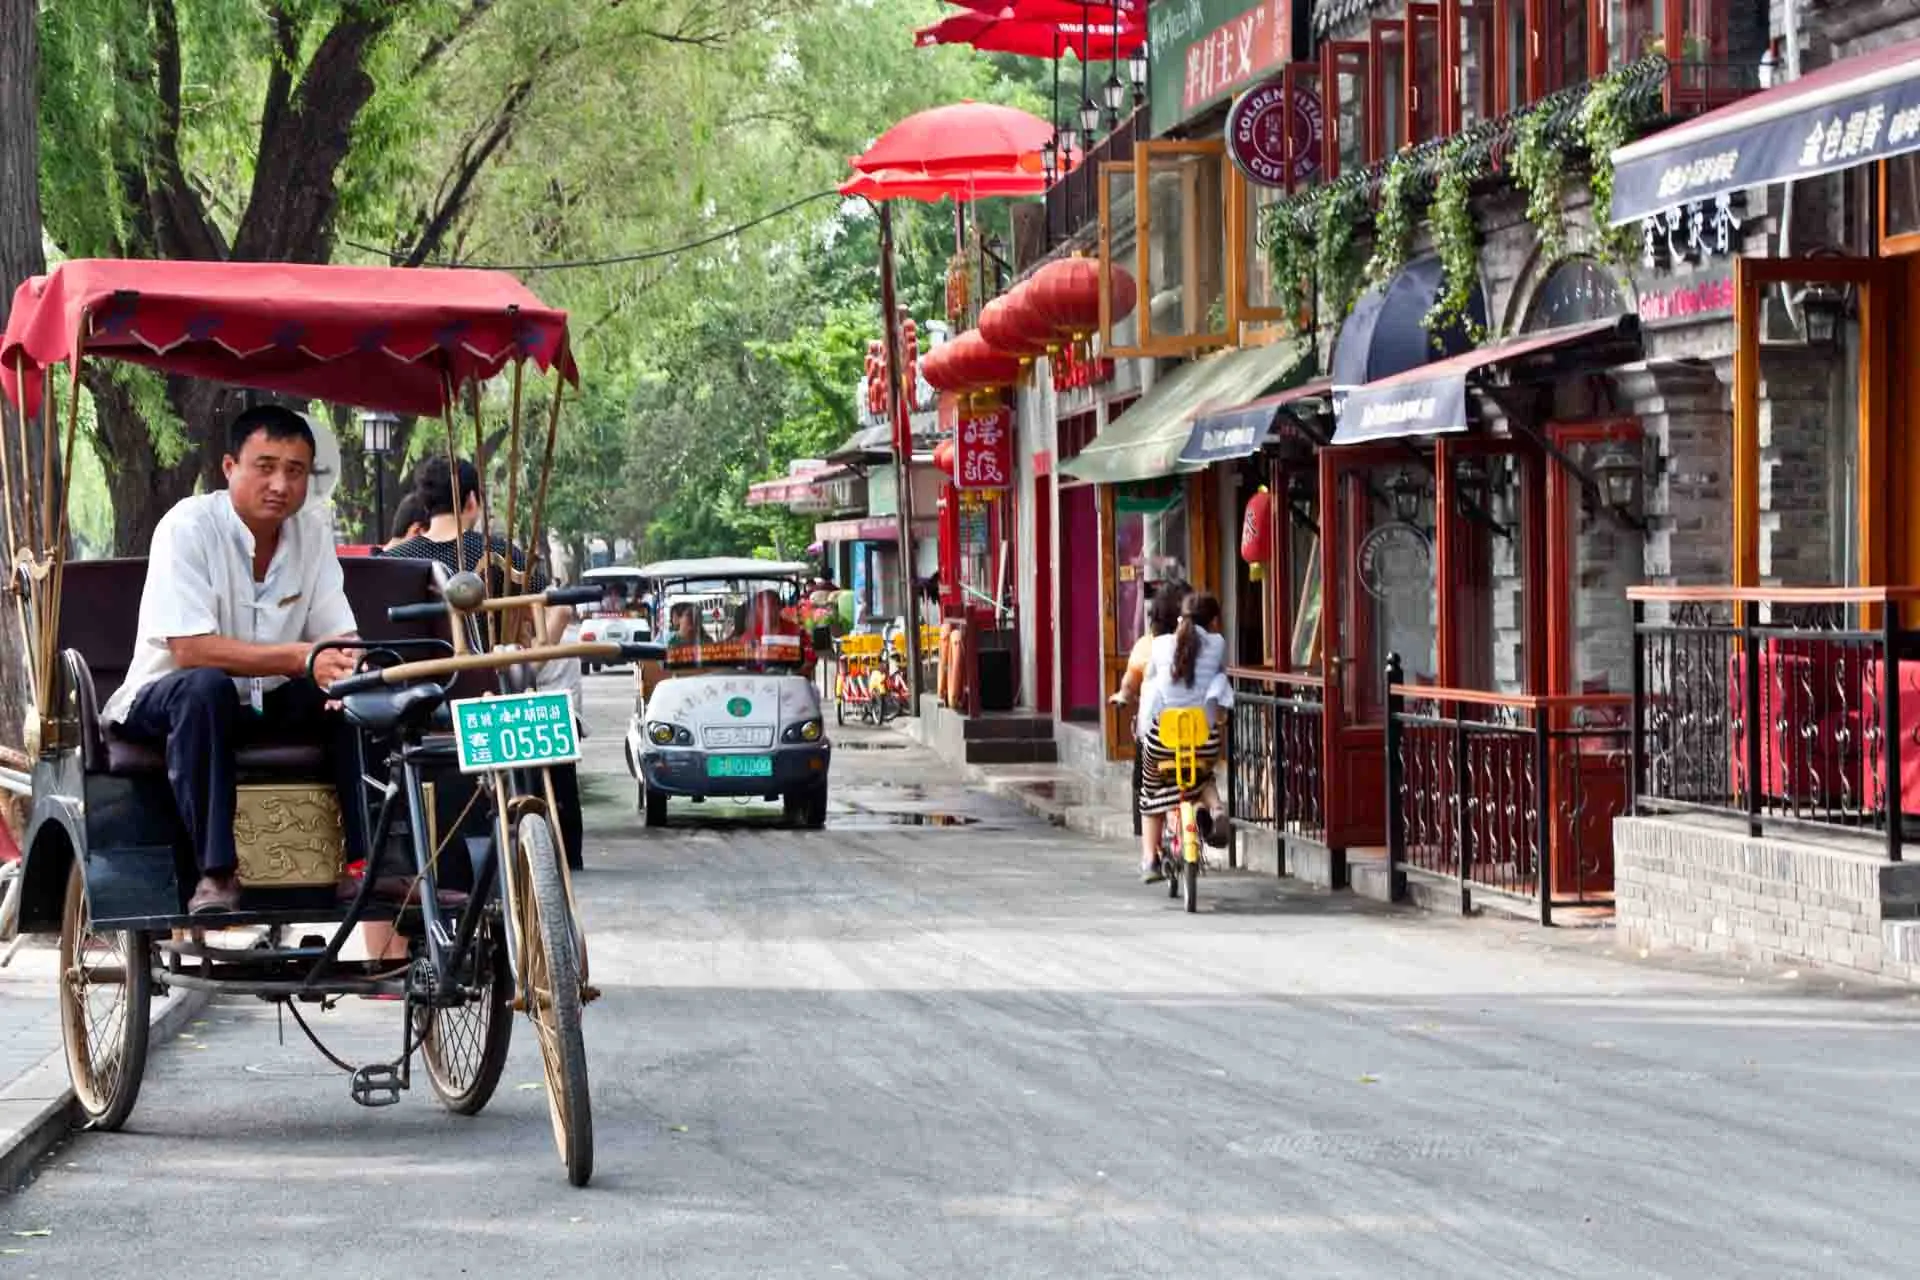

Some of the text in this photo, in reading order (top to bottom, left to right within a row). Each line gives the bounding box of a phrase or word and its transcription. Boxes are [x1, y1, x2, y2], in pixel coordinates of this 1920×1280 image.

[1239, 88, 1284, 142] GOLDEN
[1251, 157, 1314, 180] COFEE
[465, 712, 494, 729] 西城
[468, 732, 493, 763] 客运
[500, 723, 571, 760] 0555
